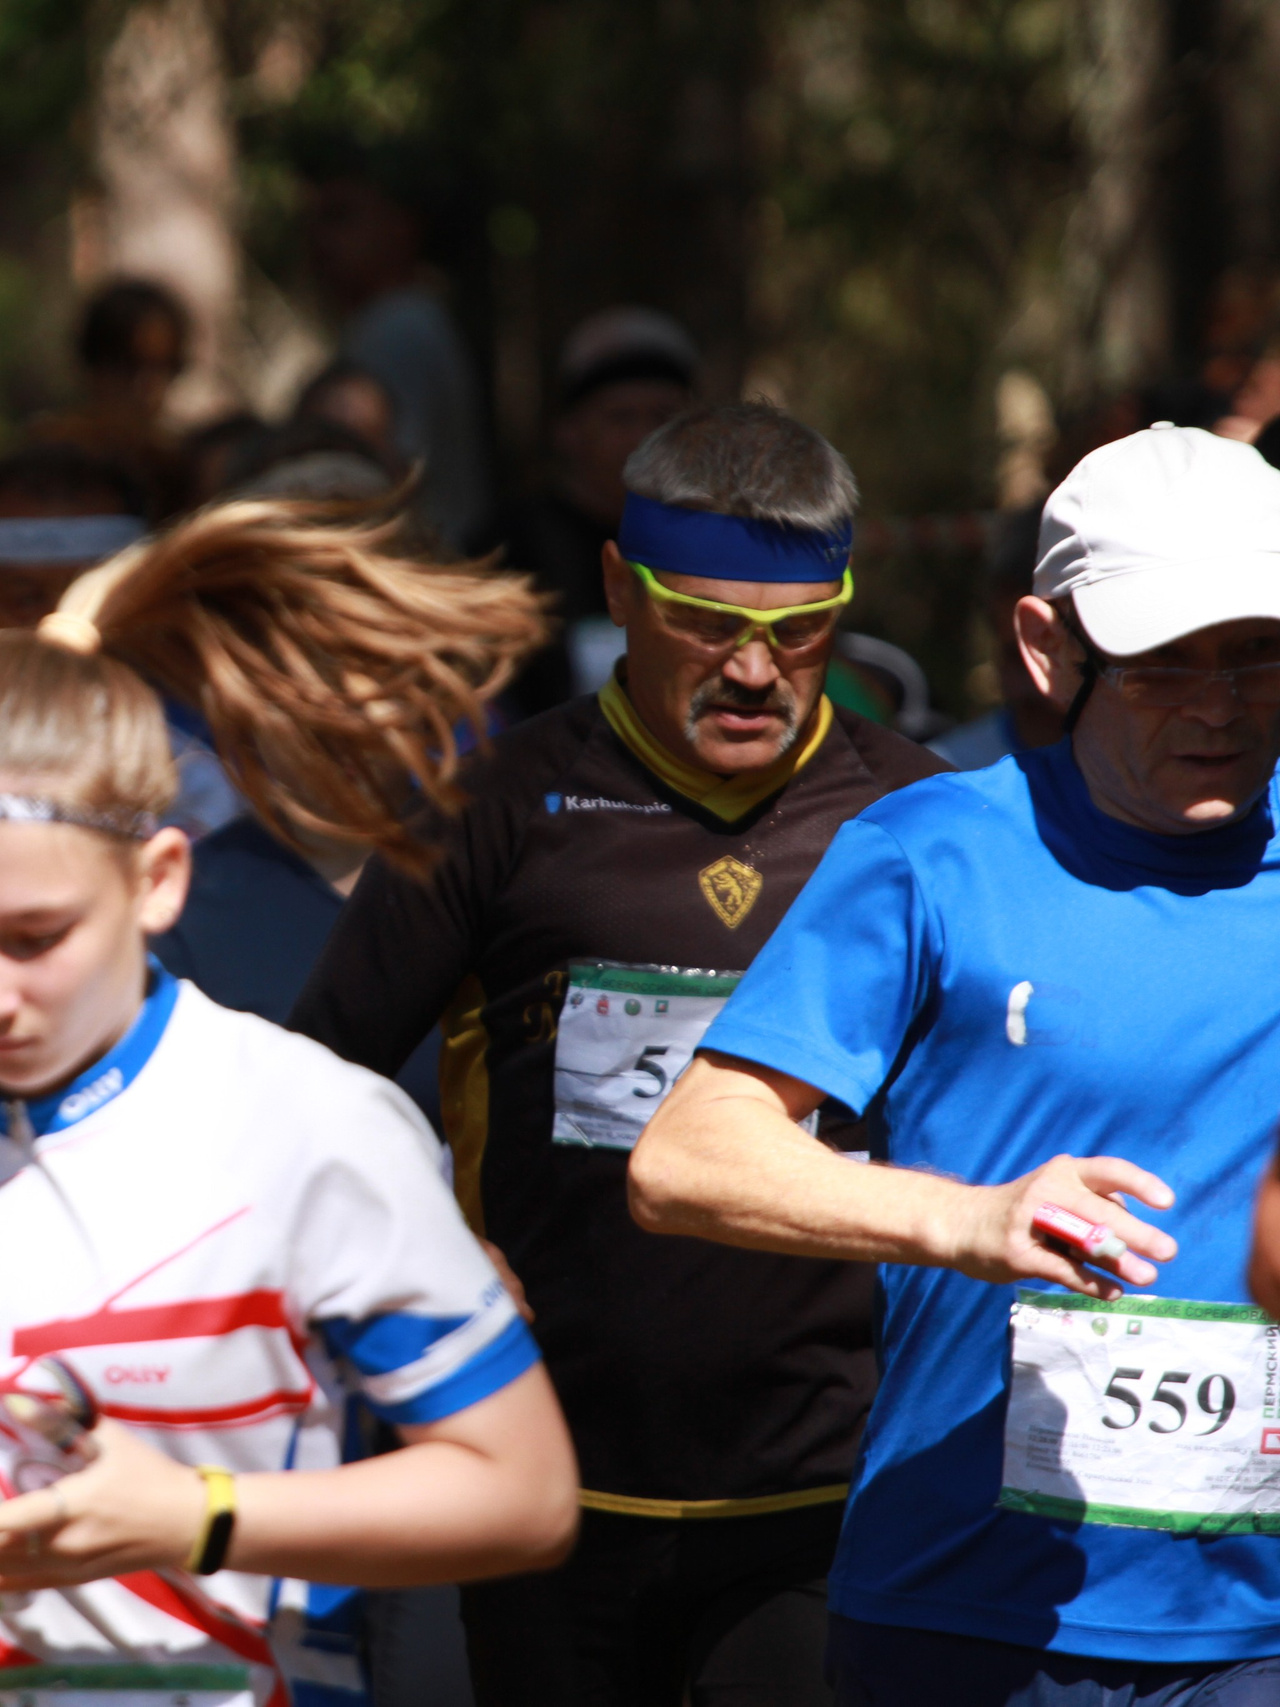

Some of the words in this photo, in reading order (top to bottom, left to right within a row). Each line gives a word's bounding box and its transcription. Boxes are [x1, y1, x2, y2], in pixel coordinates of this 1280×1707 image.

[59, 1067, 124, 1120] OLLY
[1185, 1305, 1271, 1322] СОРЕВНОВА
[104, 1364, 172, 1384] OLLY
[1100, 1366, 1237, 1437] 559
